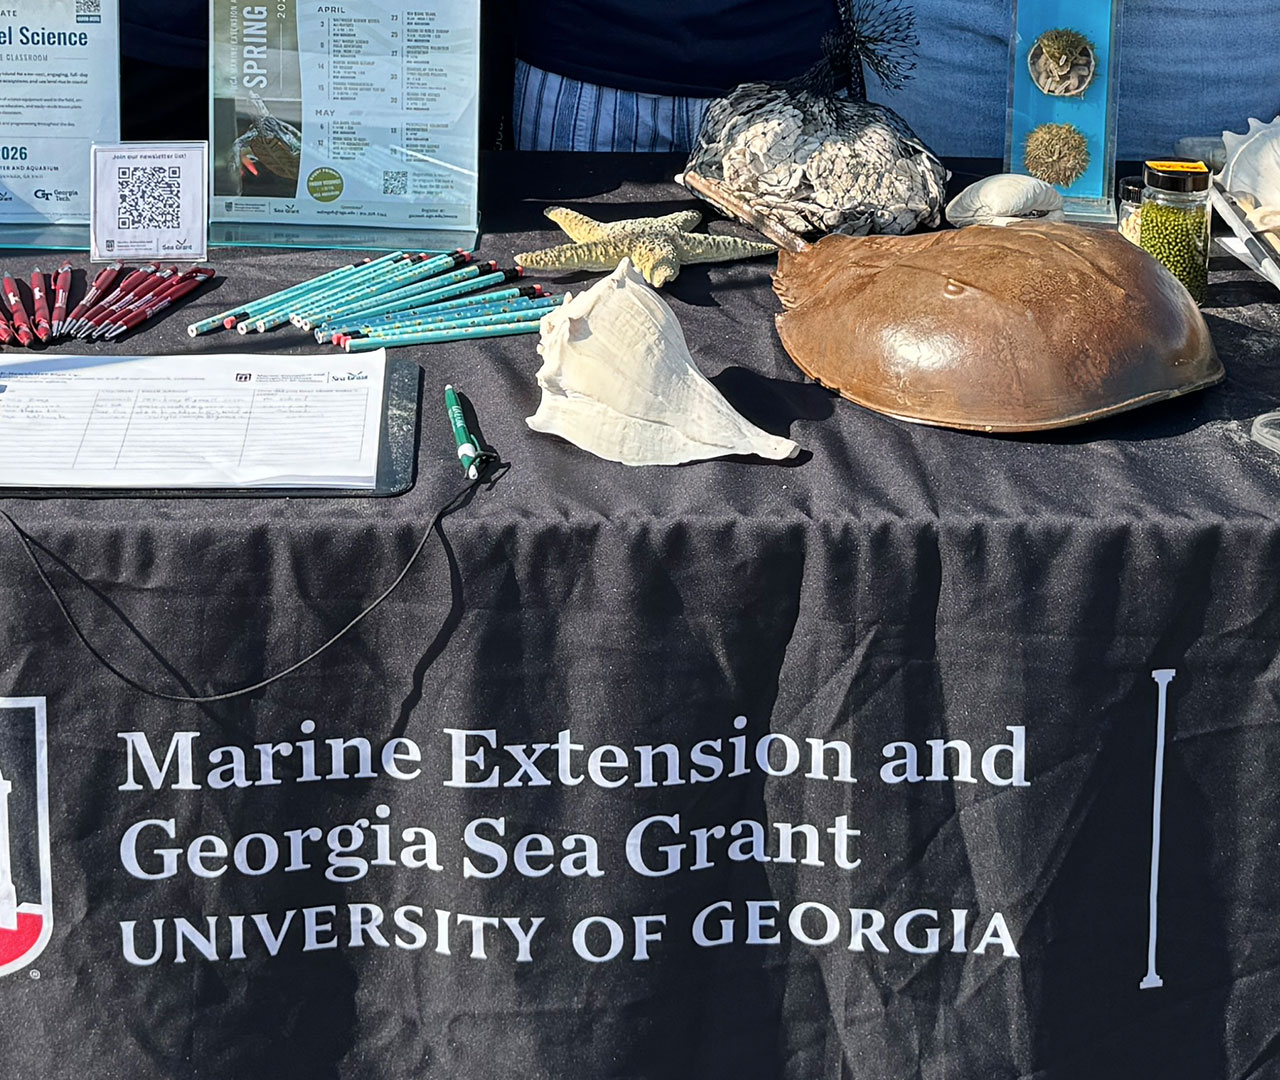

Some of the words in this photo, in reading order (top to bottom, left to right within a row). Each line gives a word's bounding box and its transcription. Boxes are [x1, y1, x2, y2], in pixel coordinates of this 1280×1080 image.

[19, 26, 88, 46] Science
[317, 6, 346, 14] APRIL
[242, 5, 268, 89] SPRING
[315, 109, 336, 117] MAY
[118, 719, 423, 792] Marine
[442, 716, 858, 788] Extension
[880, 725, 1031, 788] and
[119, 804, 444, 884] Georgia
[463, 816, 606, 880] Sea
[625, 813, 862, 879] Grant
[120, 903, 546, 968] UNIVERSITY
[571, 913, 668, 963] OF
[691, 900, 1021, 958] GEORGIA
